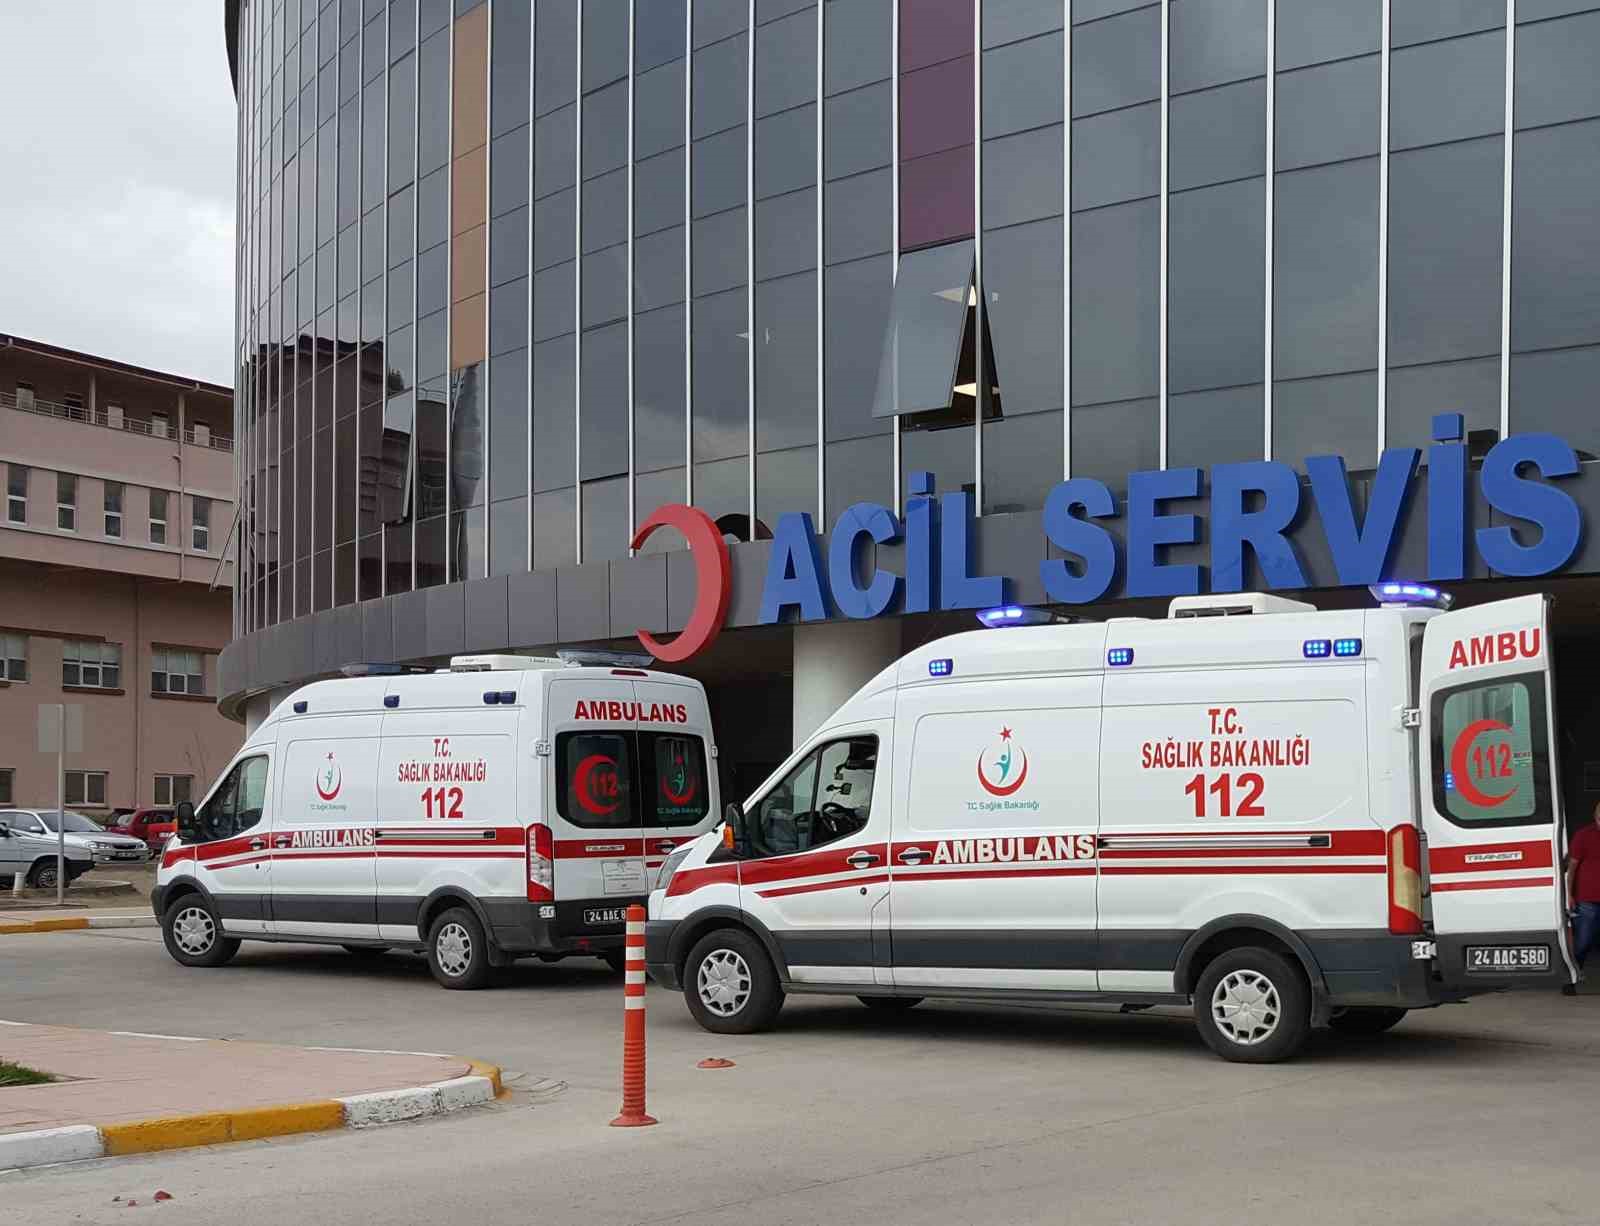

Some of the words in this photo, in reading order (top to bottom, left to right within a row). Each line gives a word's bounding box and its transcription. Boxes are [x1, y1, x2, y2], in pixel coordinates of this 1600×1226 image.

[758, 471, 1005, 624] ACİL
[1040, 413, 1582, 603] SERVİS
[1449, 628, 1541, 669] AMBU
[575, 700, 687, 722] AMBULANS
[1208, 708, 1243, 735] T.C.
[433, 737, 452, 758] T.C.
[1142, 736, 1204, 769] SAĞLIK
[1210, 734, 1310, 767] BAKANLIĞI
[1473, 743, 1513, 779] 112
[398, 759, 431, 782] SAĞLIK
[433, 758, 486, 782] BAKANLIĞI
[591, 770, 618, 798] 112
[421, 787, 464, 818] 112
[1185, 773, 1264, 817] 112
[291, 829, 374, 848] AMBULANS
[933, 835, 1095, 864] AMBULANS
[590, 911, 601, 921] 24
[1474, 950, 1490, 965] 24
[1493, 949, 1517, 965] AAC
[1520, 949, 1545, 965] 580
